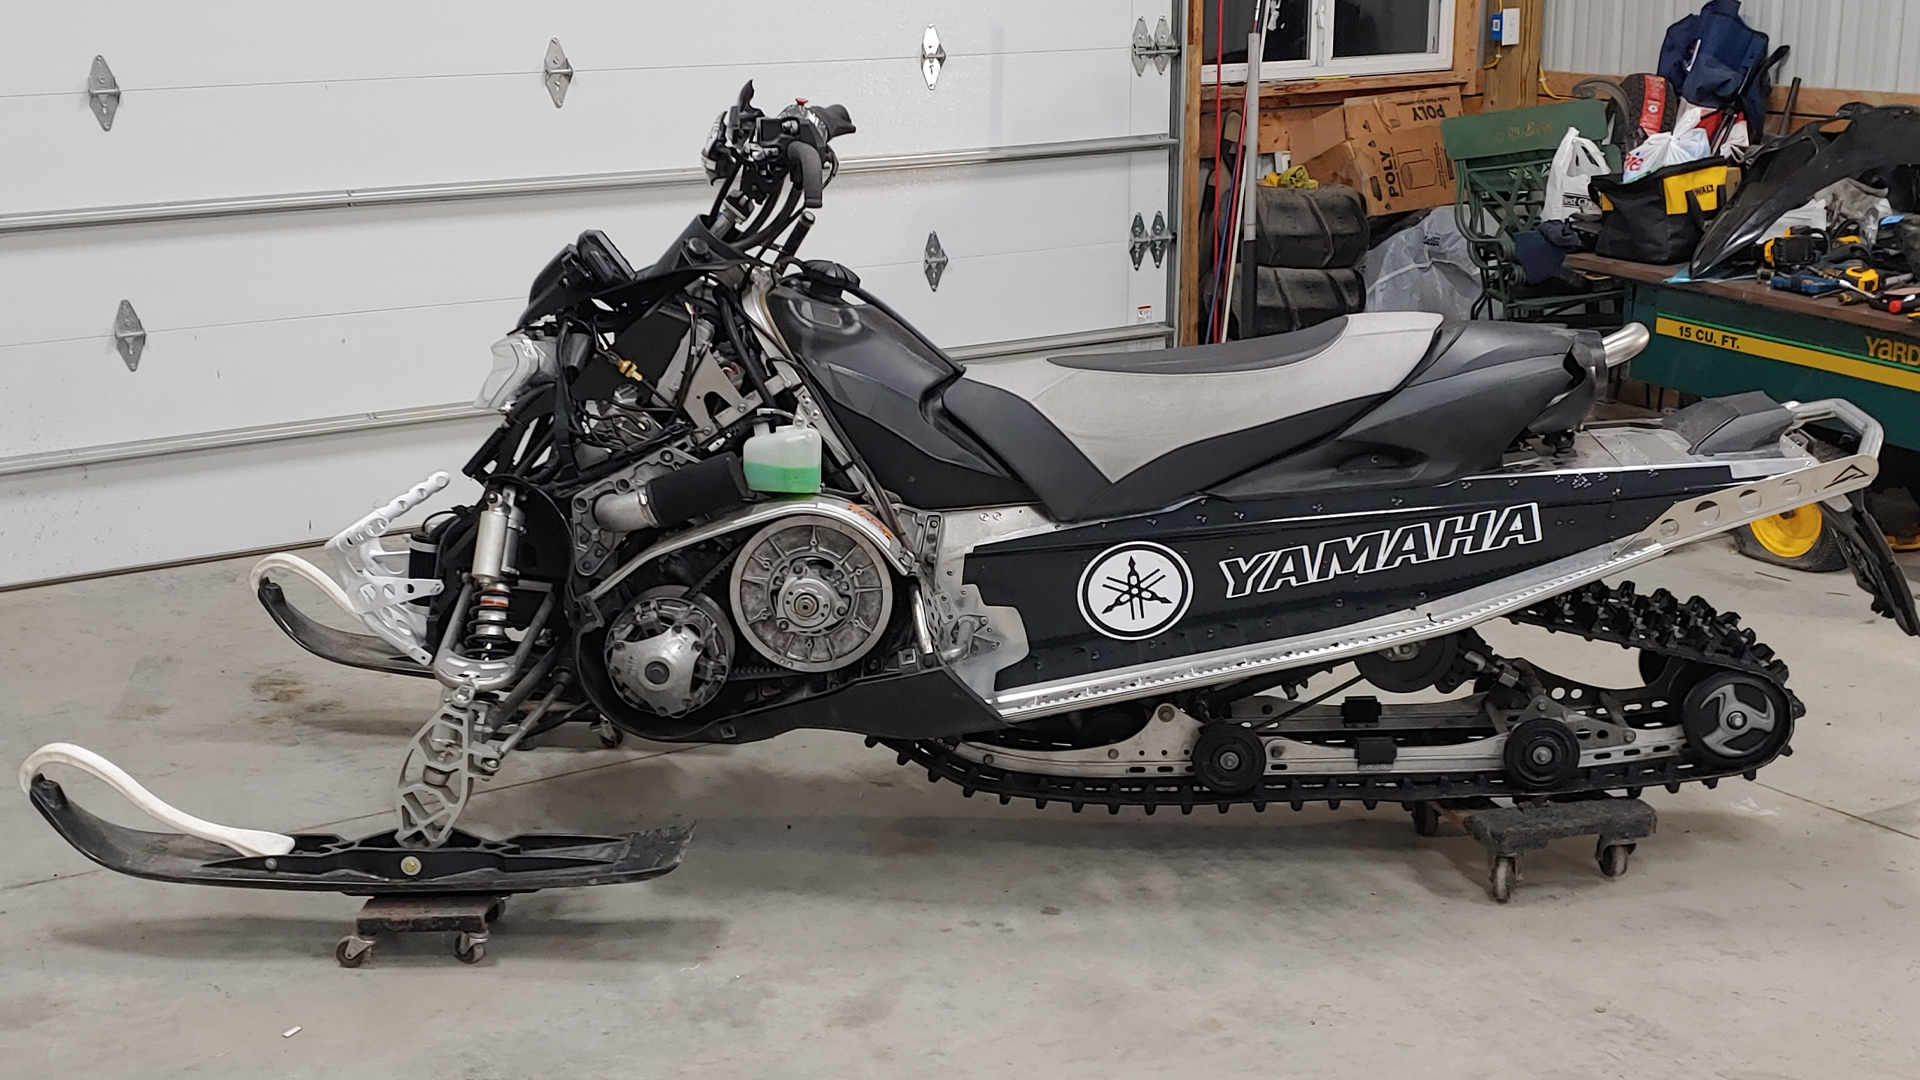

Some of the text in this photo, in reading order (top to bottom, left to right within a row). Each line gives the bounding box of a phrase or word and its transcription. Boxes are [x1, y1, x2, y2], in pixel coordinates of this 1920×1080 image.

[1411, 104, 1447, 122] POLY
[1378, 150, 1400, 198] POLY
[1678, 326, 1740, 349] 15 CU. FT.
[1218, 502, 1543, 599] YAMAHA
